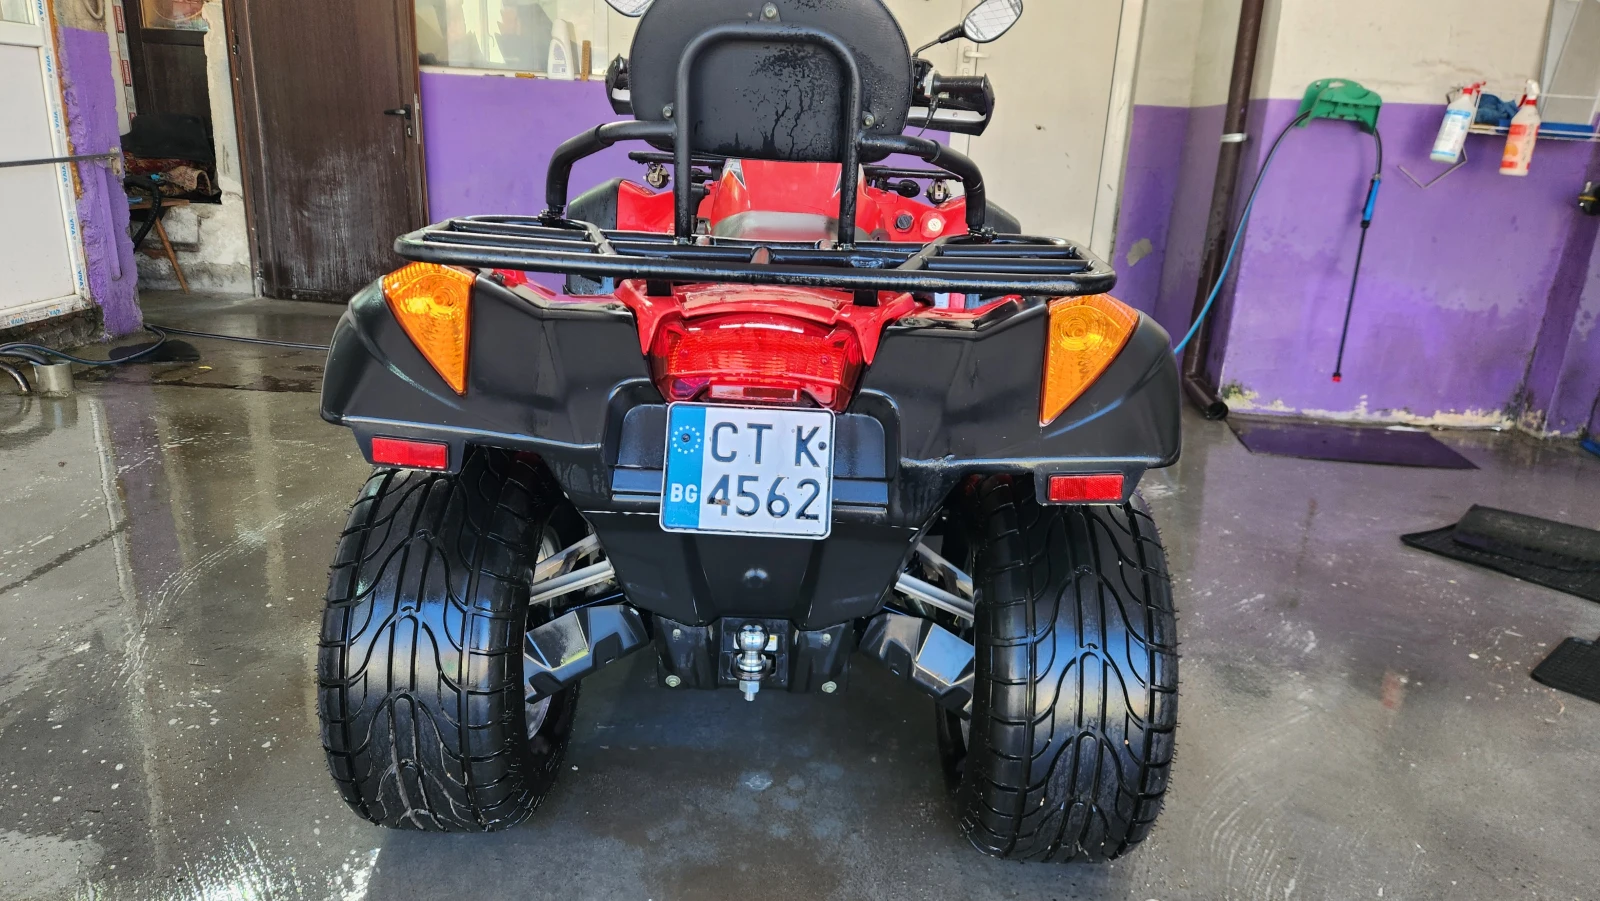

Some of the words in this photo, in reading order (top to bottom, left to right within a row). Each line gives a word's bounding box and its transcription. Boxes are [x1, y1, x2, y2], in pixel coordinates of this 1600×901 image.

[711, 421, 773, 465] CT
[670, 483, 698, 504] BG
[706, 474, 821, 521] 4562
